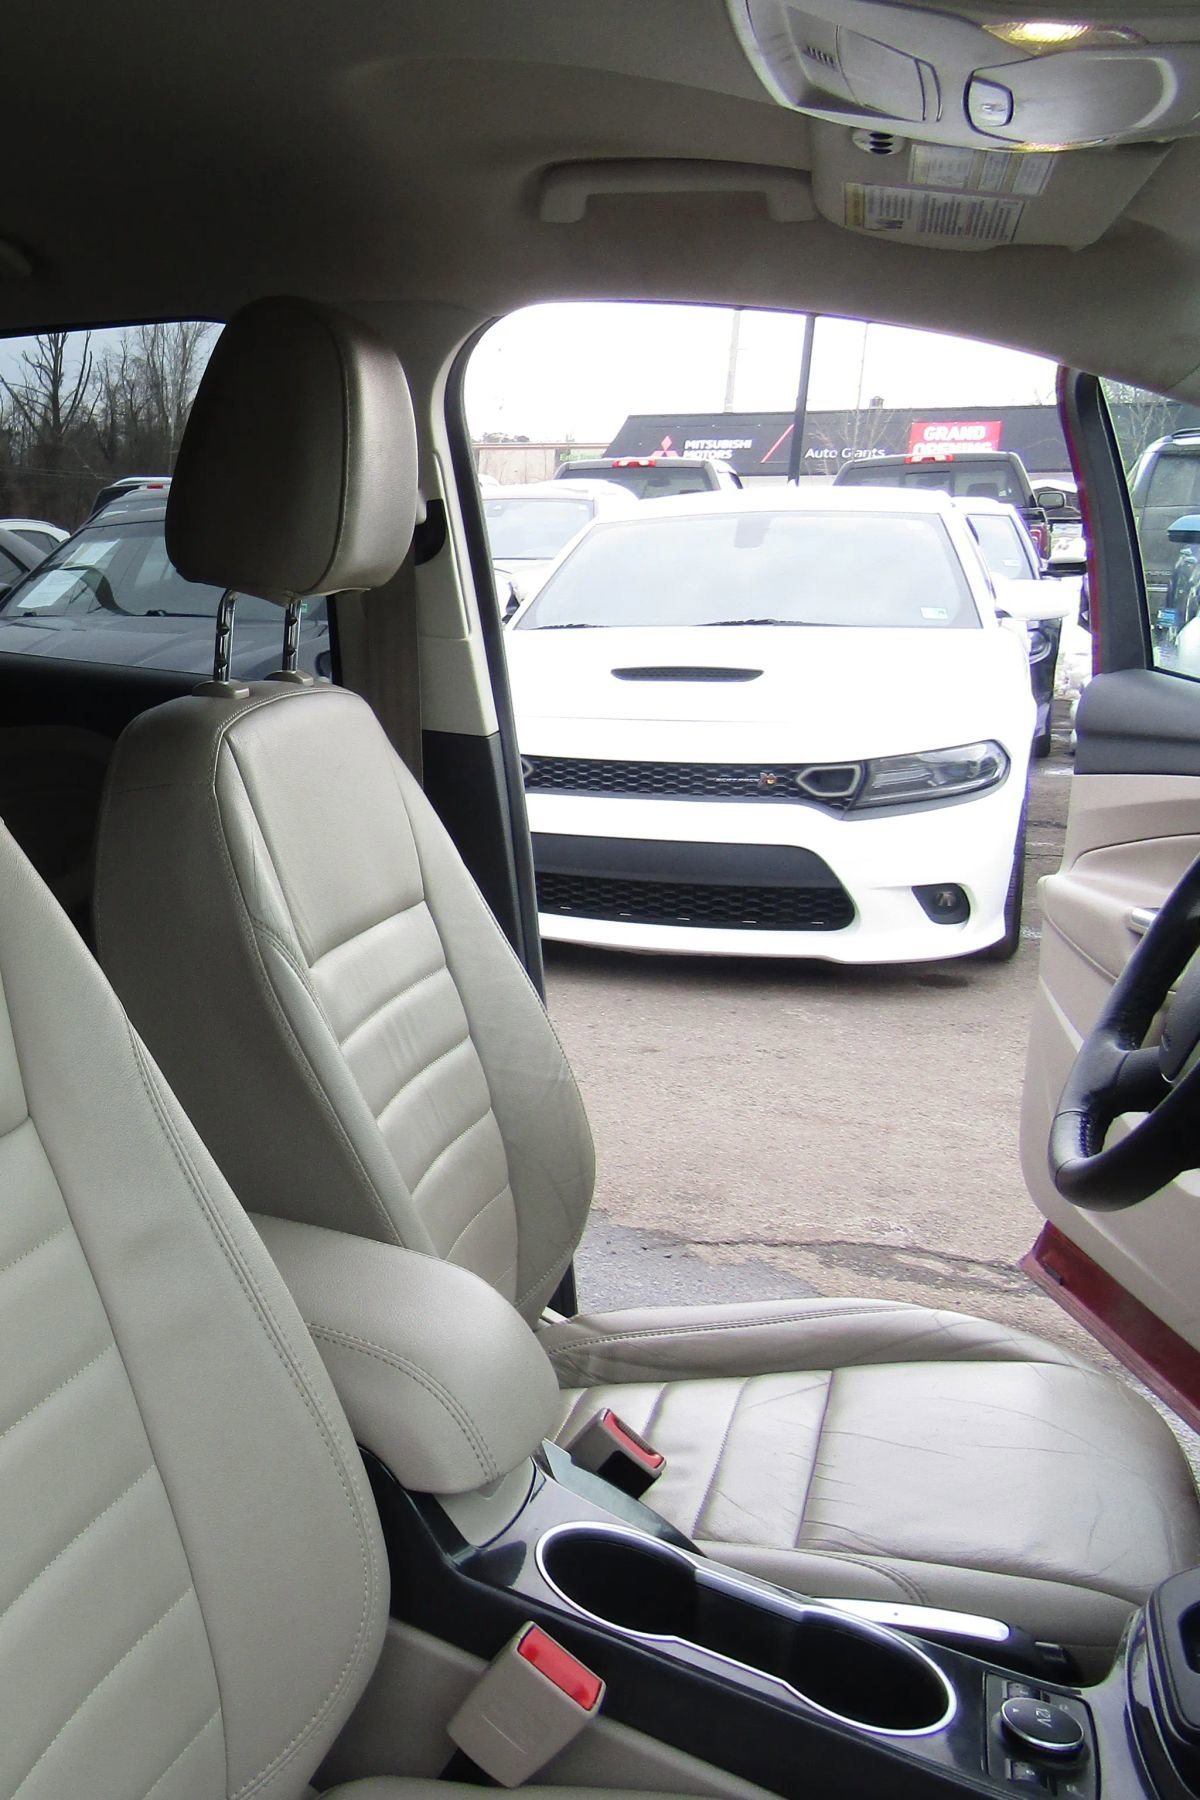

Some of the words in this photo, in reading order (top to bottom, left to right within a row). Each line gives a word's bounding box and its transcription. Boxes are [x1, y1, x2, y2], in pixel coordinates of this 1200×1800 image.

[923, 425, 986, 441] GRAND
[684, 439, 753, 449] MITSUBISHI
[683, 449, 733, 459] MOTORS
[804, 447, 838, 459] Auto
